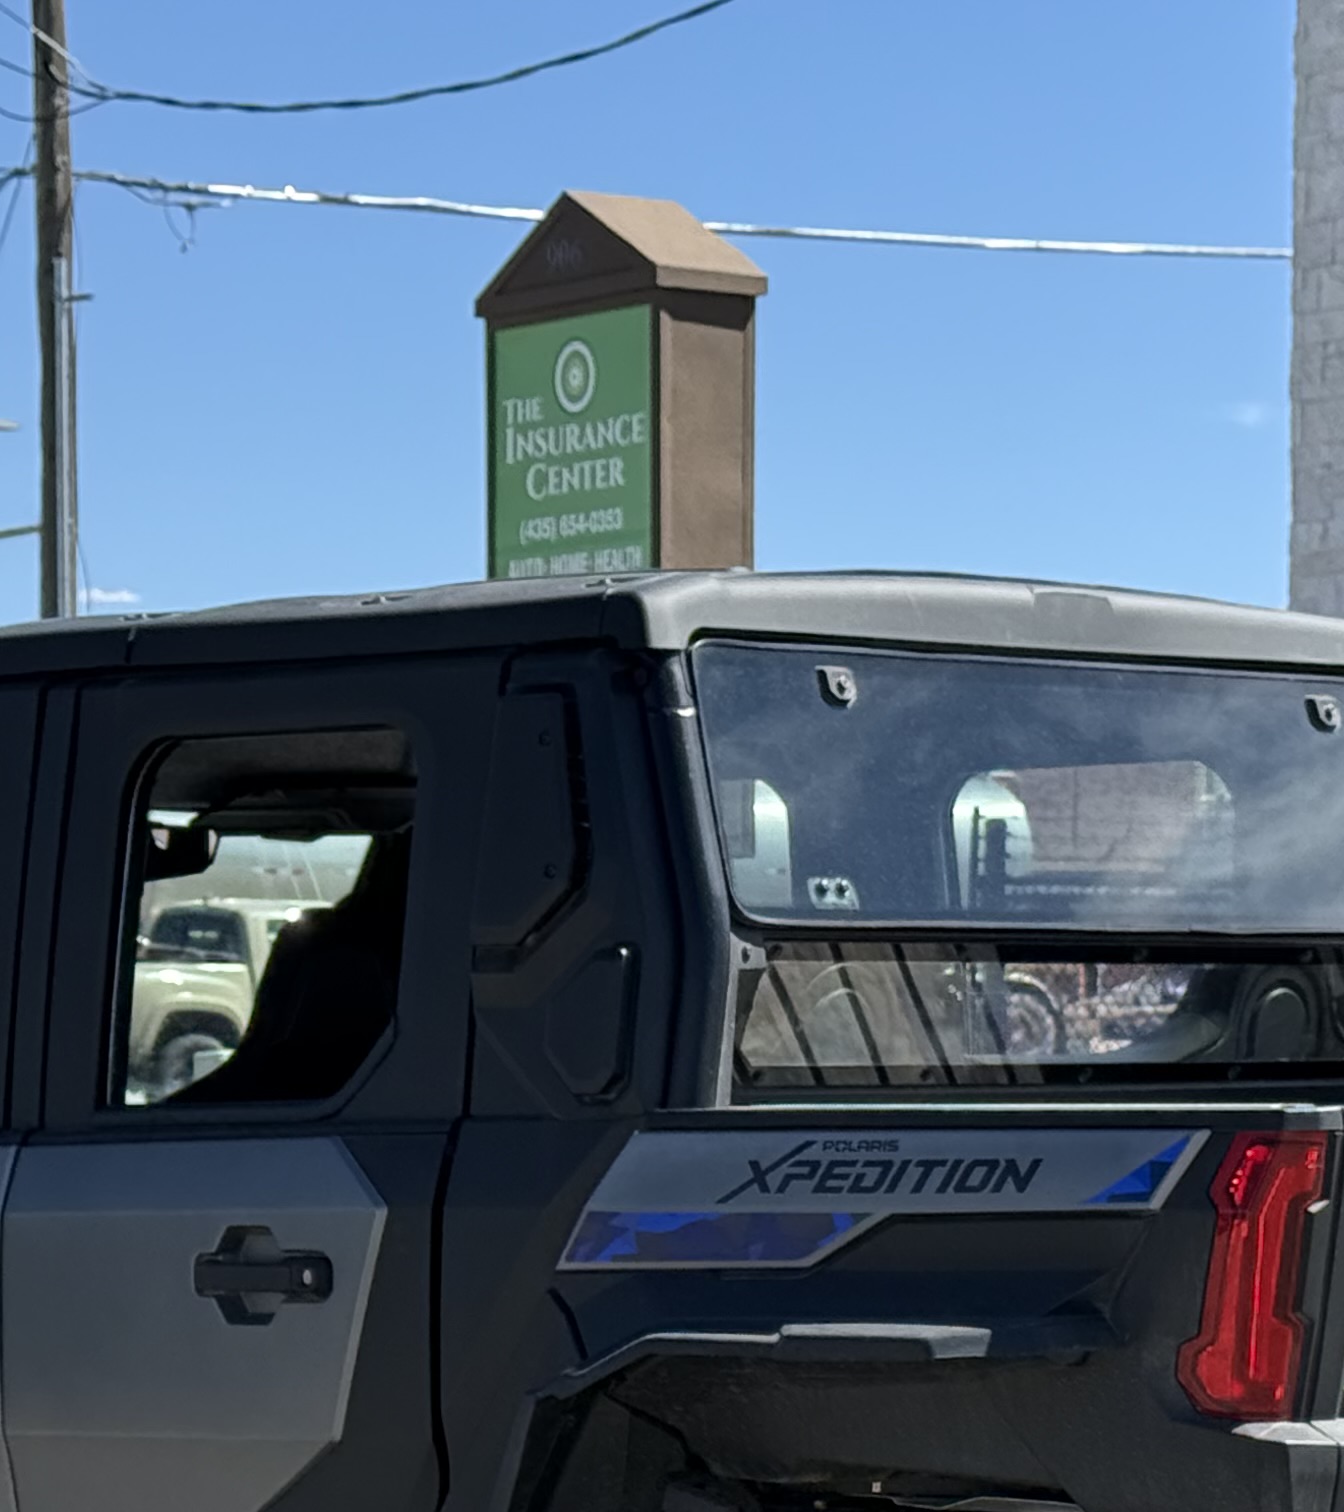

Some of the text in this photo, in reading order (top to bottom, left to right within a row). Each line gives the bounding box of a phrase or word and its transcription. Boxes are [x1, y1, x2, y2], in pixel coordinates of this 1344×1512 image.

[503, 396, 544, 425] THE
[505, 411, 646, 465] INSURANCE
[525, 457, 625, 501] CENTER
[594, 546, 643, 571] HEALTH
[821, 1139, 900, 1153] POLARIS
[716, 1140, 1043, 1205] XPEDITION
